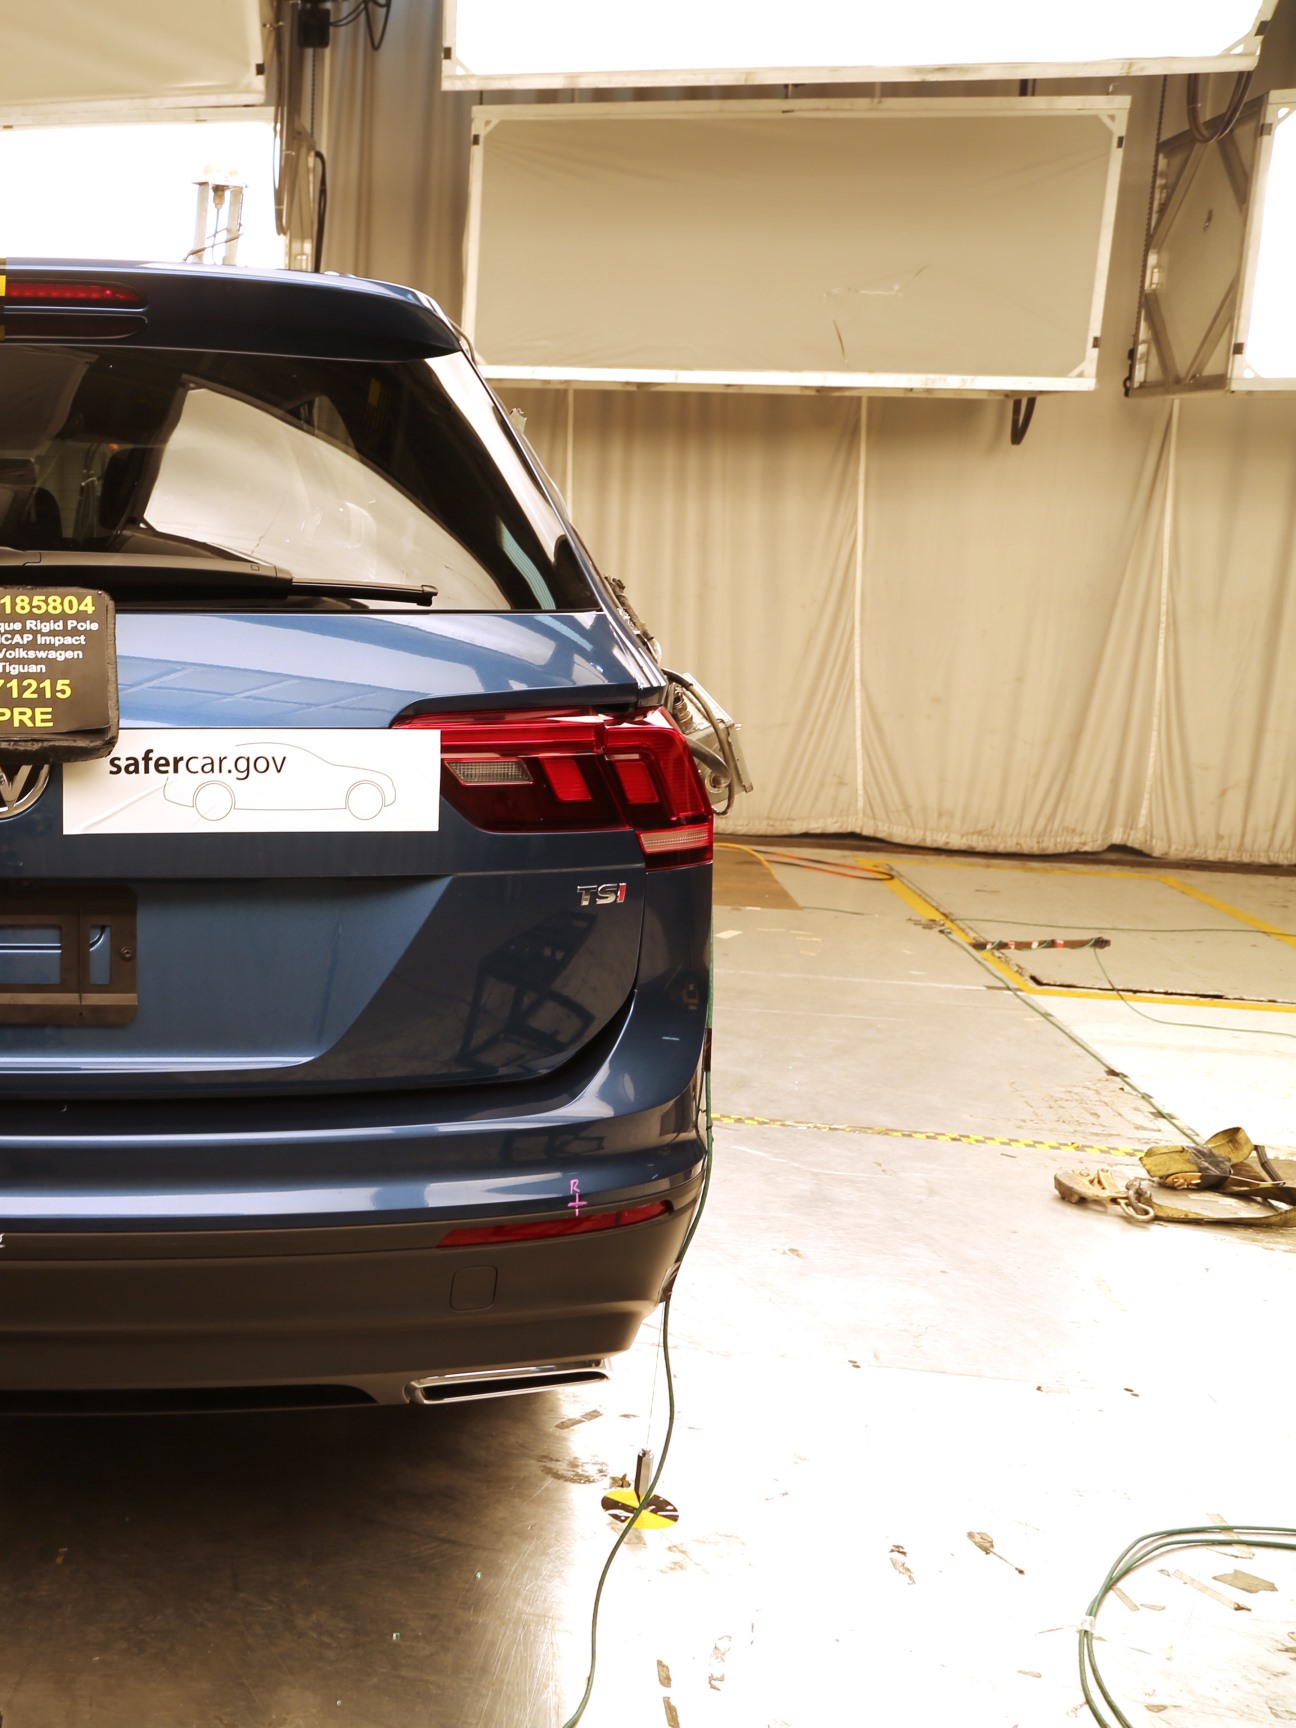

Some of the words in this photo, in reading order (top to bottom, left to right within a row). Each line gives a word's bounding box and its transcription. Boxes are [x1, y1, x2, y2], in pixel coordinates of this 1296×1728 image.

[26, 619, 64, 633] Rigid
[67, 619, 100, 632] Pole
[37, 633, 87, 647] Impact
[109, 749, 287, 780] safercar.gov
[576, 883, 627, 906] TSI
